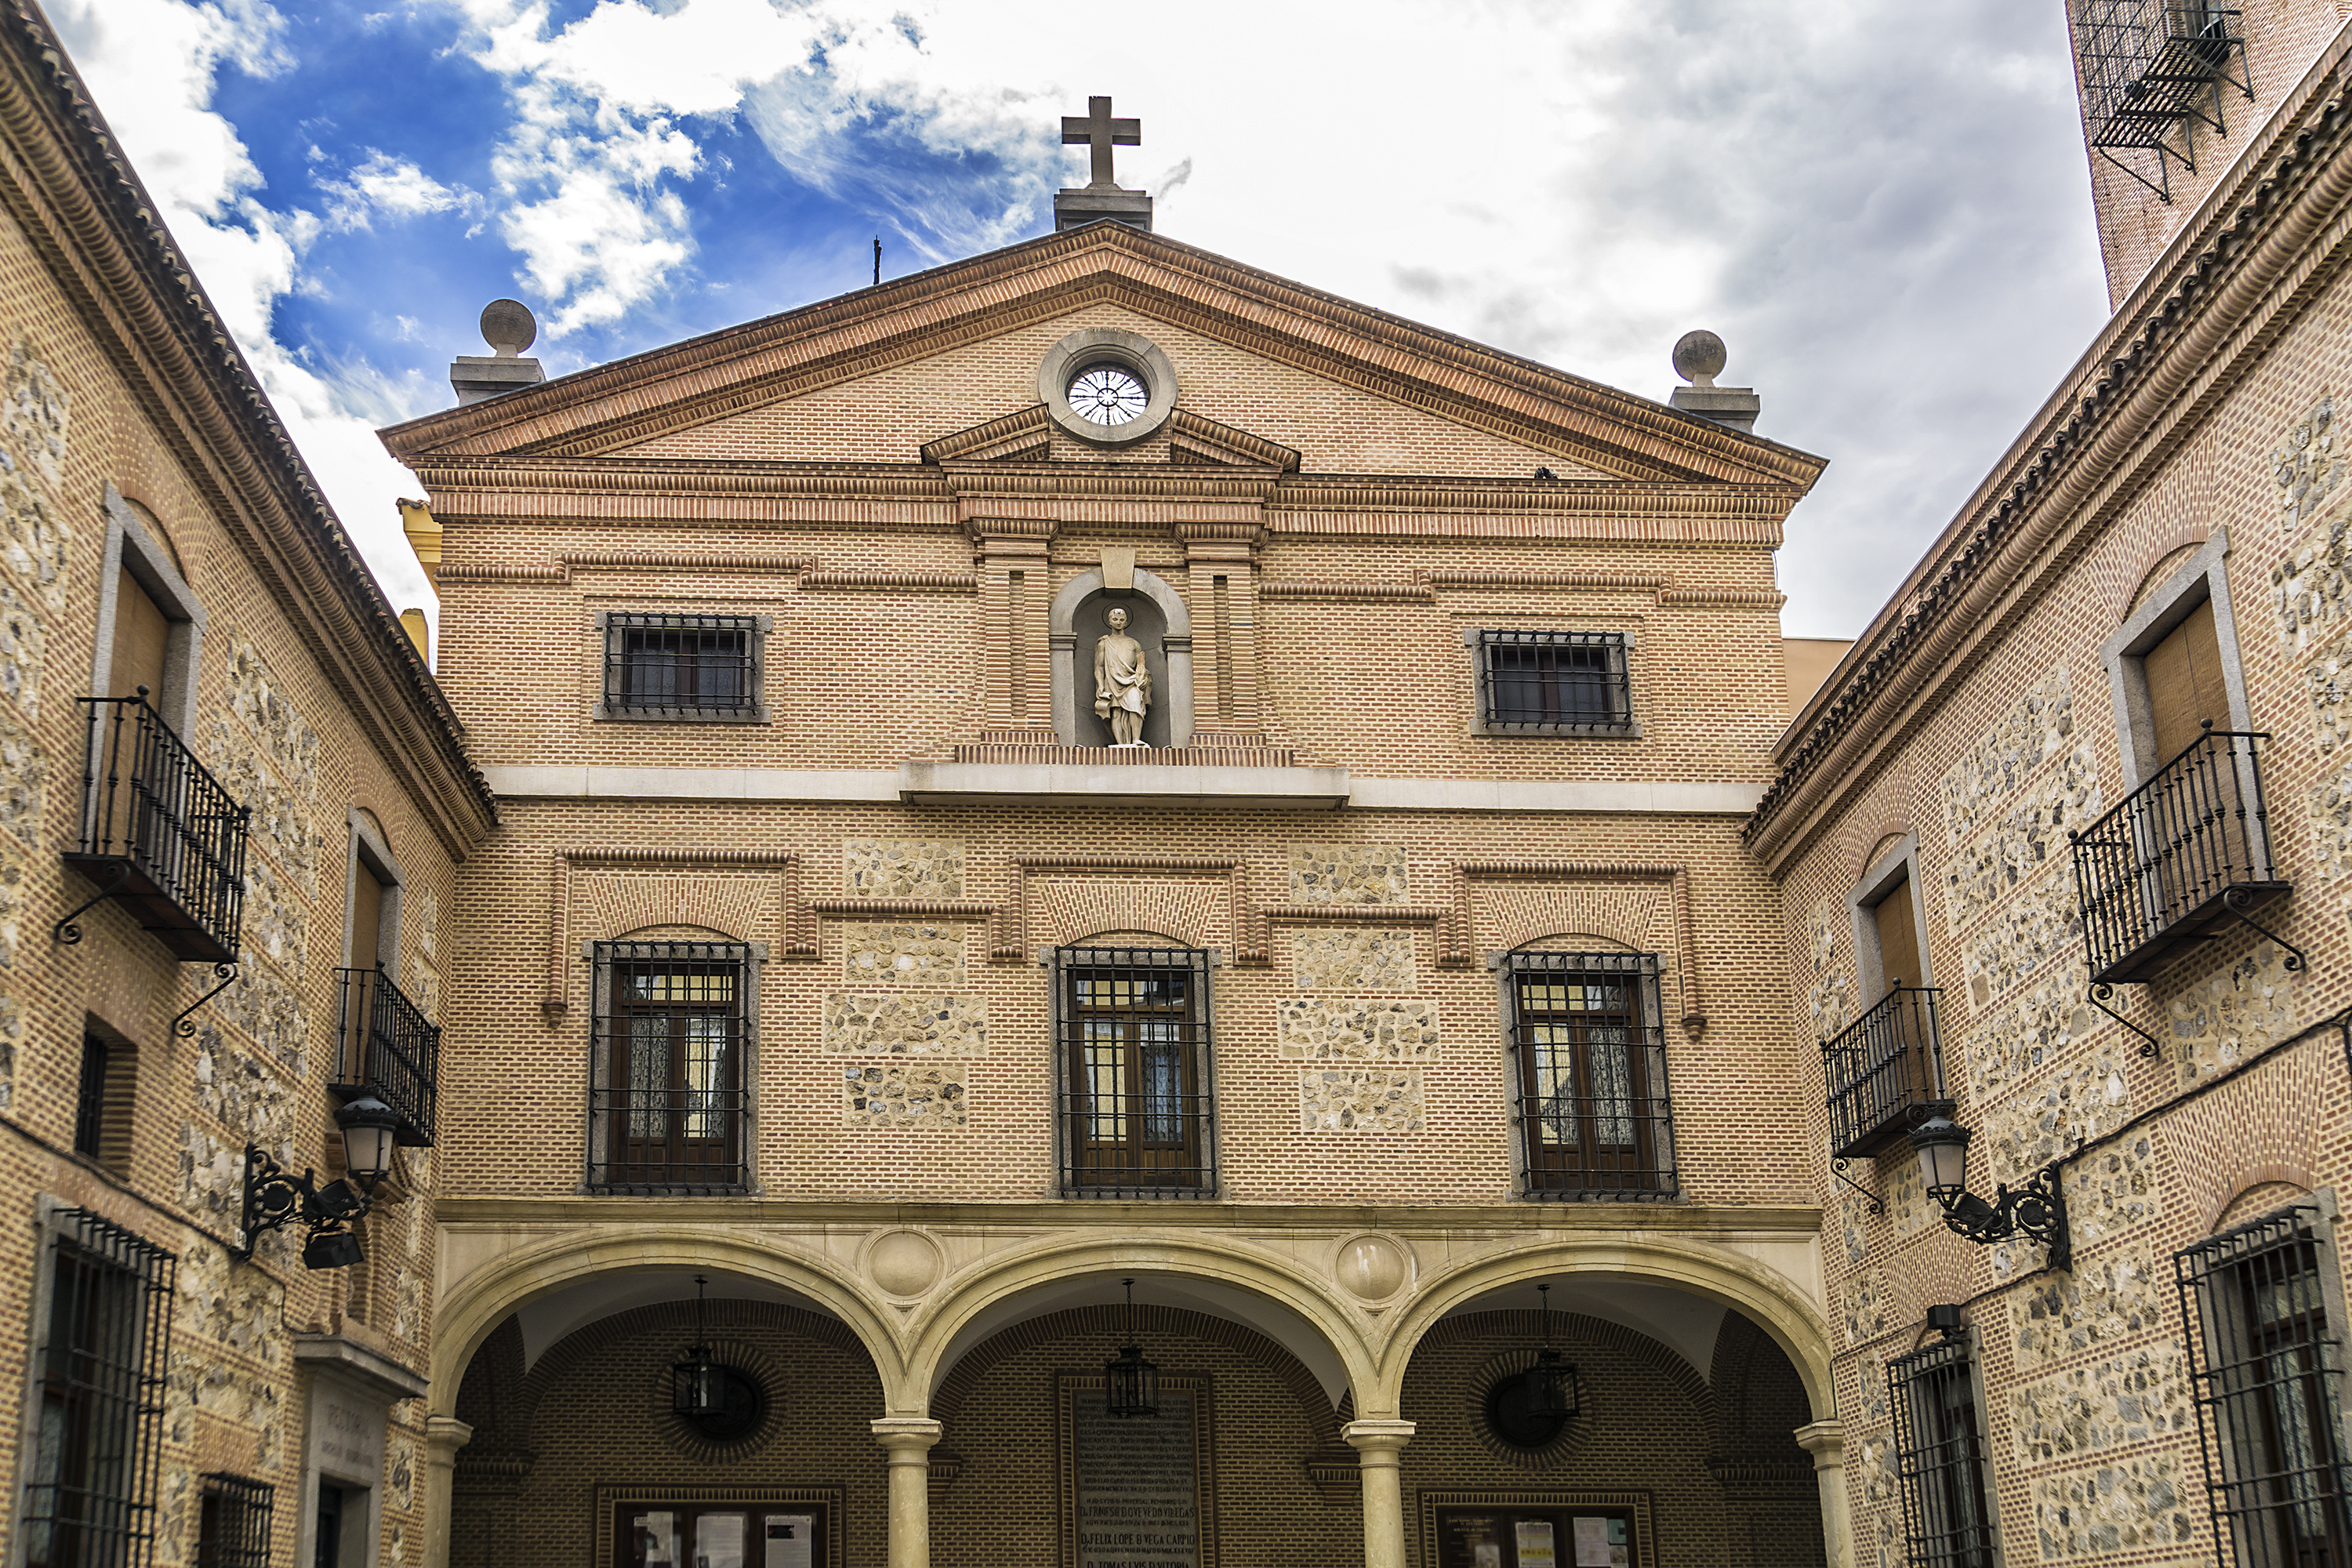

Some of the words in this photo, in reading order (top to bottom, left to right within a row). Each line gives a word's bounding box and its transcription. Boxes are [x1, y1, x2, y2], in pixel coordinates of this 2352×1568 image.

[1090, 1534, 1112, 1544] FELIX
[1144, 1534, 1163, 1544] VEGA
[1166, 1534, 1196, 1544] CARPIO
